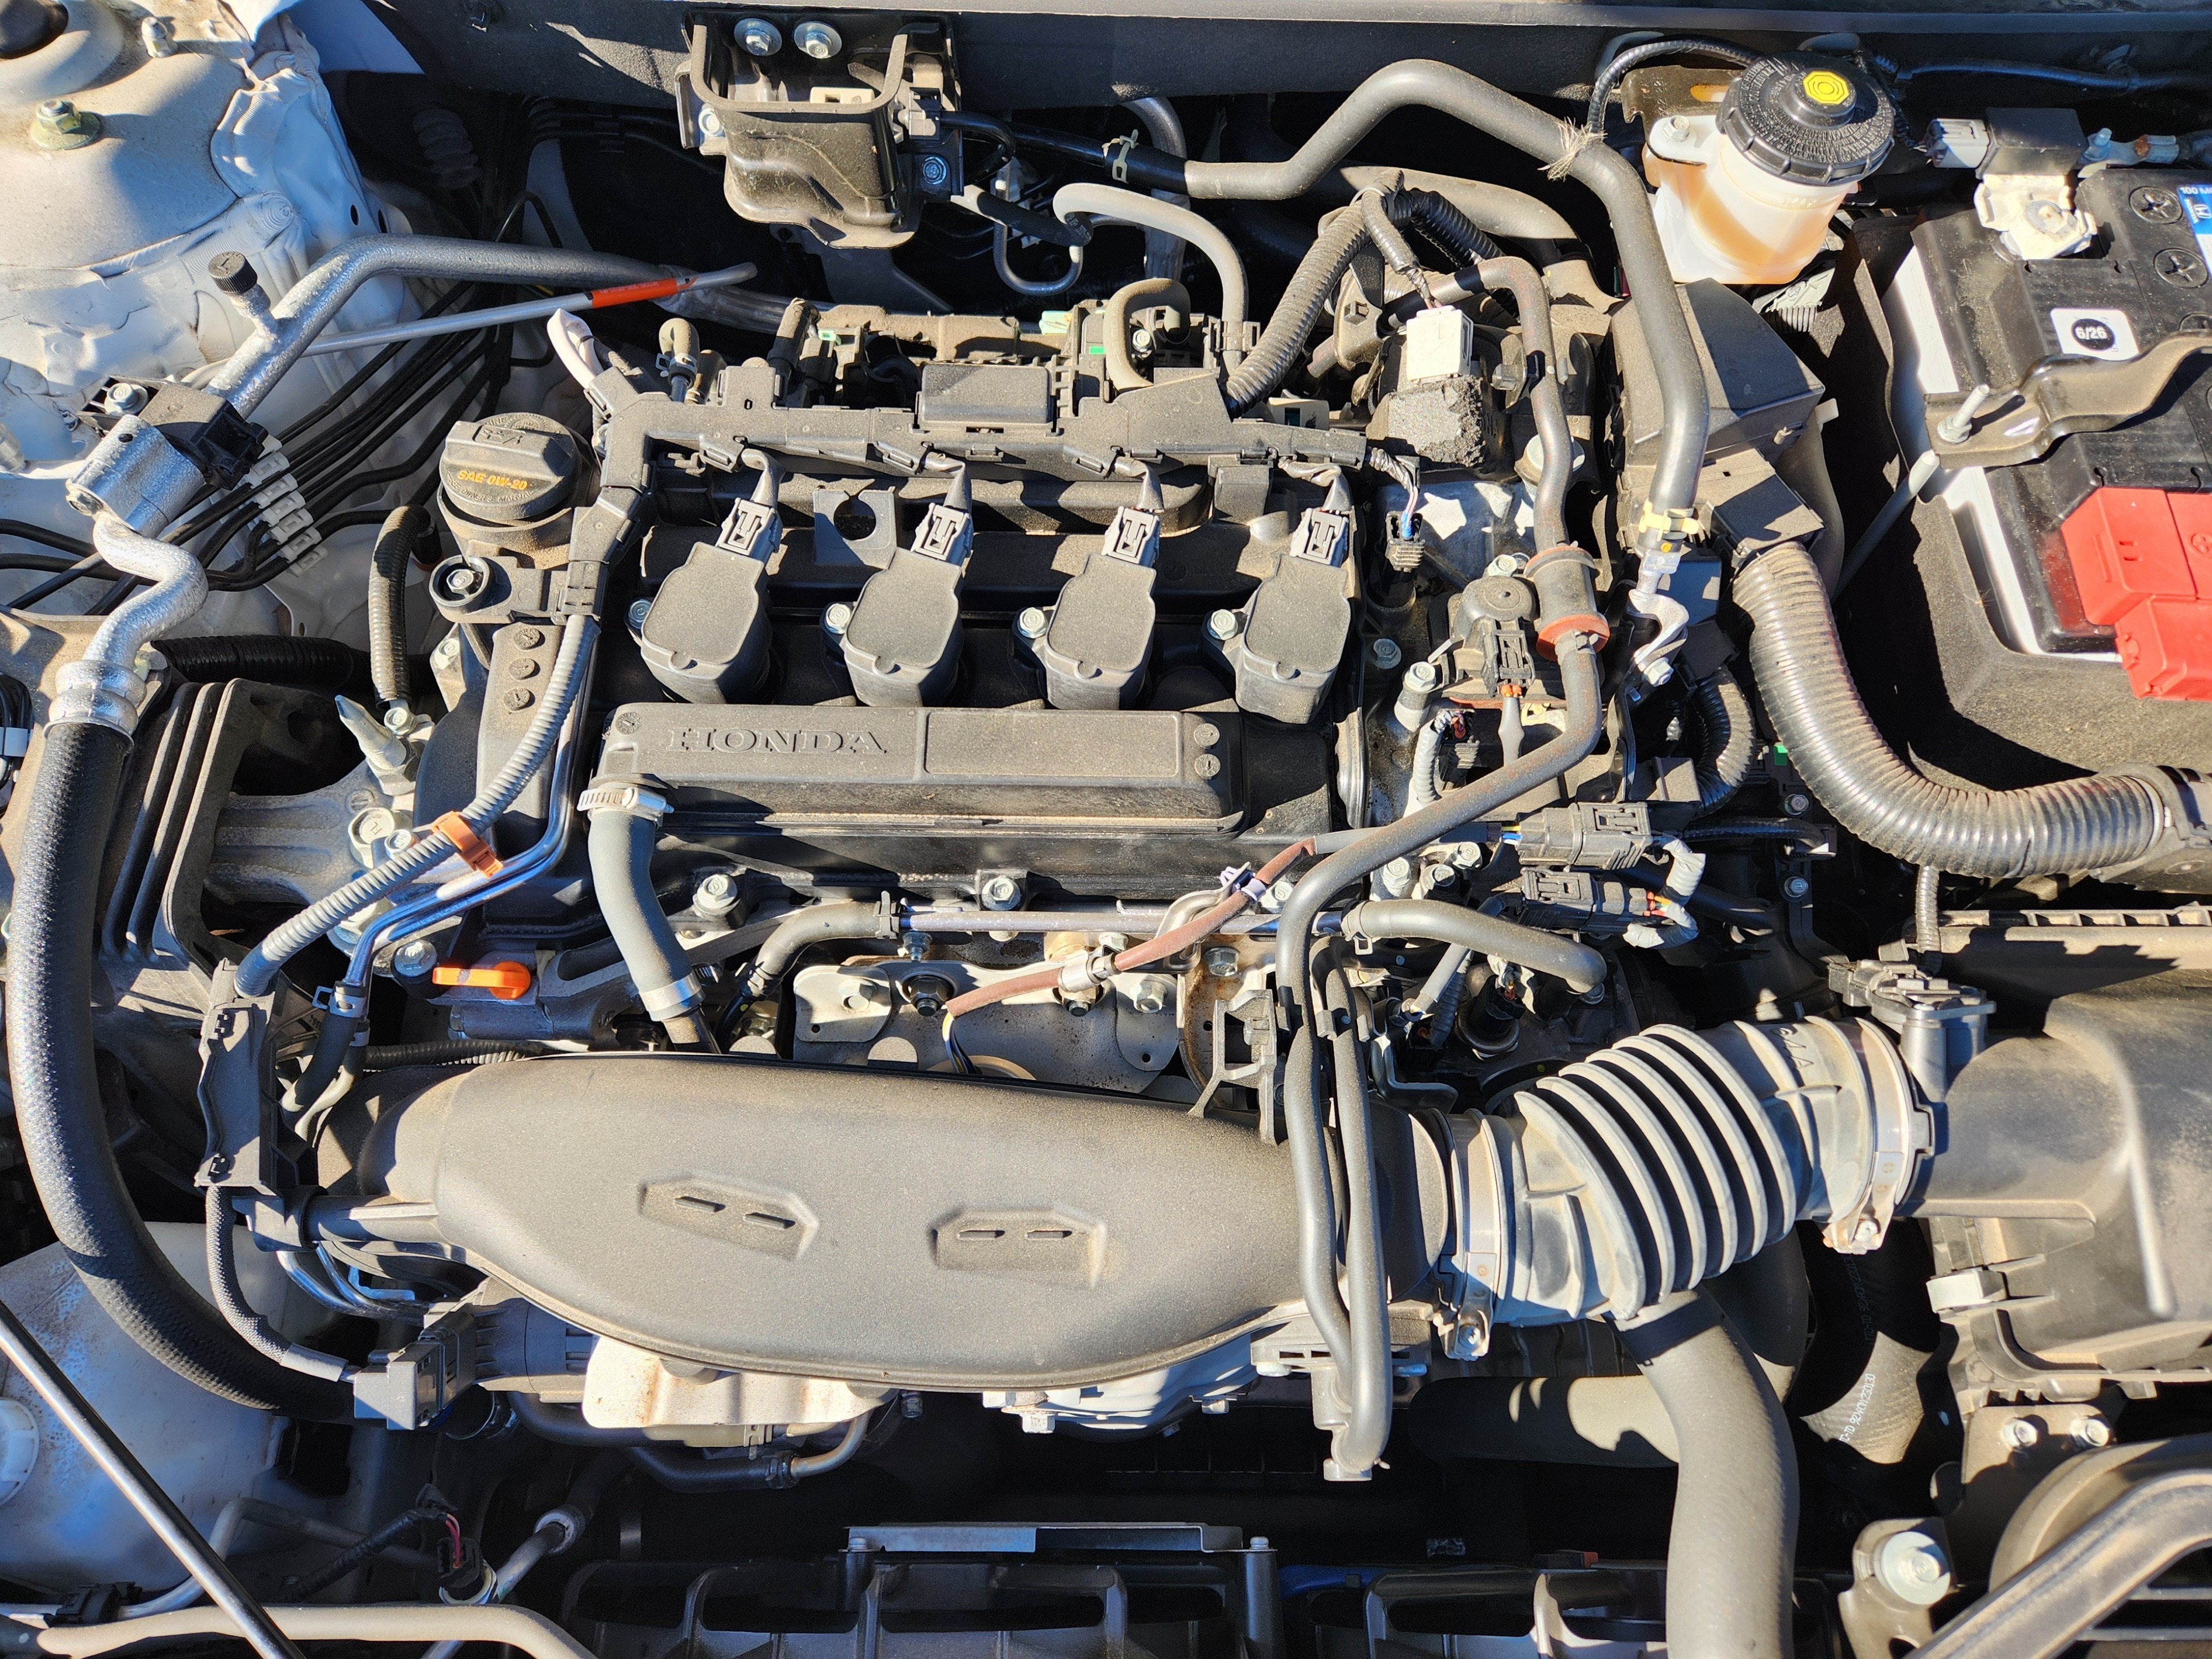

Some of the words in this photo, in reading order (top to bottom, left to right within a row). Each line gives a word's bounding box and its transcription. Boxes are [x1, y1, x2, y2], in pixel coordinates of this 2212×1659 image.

[2075, 326, 2107, 340] 6/26
[457, 469, 487, 483] SAE
[487, 474, 529, 491] 0W-20
[461, 489, 493, 502] OWNER'S
[499, 491, 534, 503] MANUAL
[665, 728, 887, 753] HONDA
